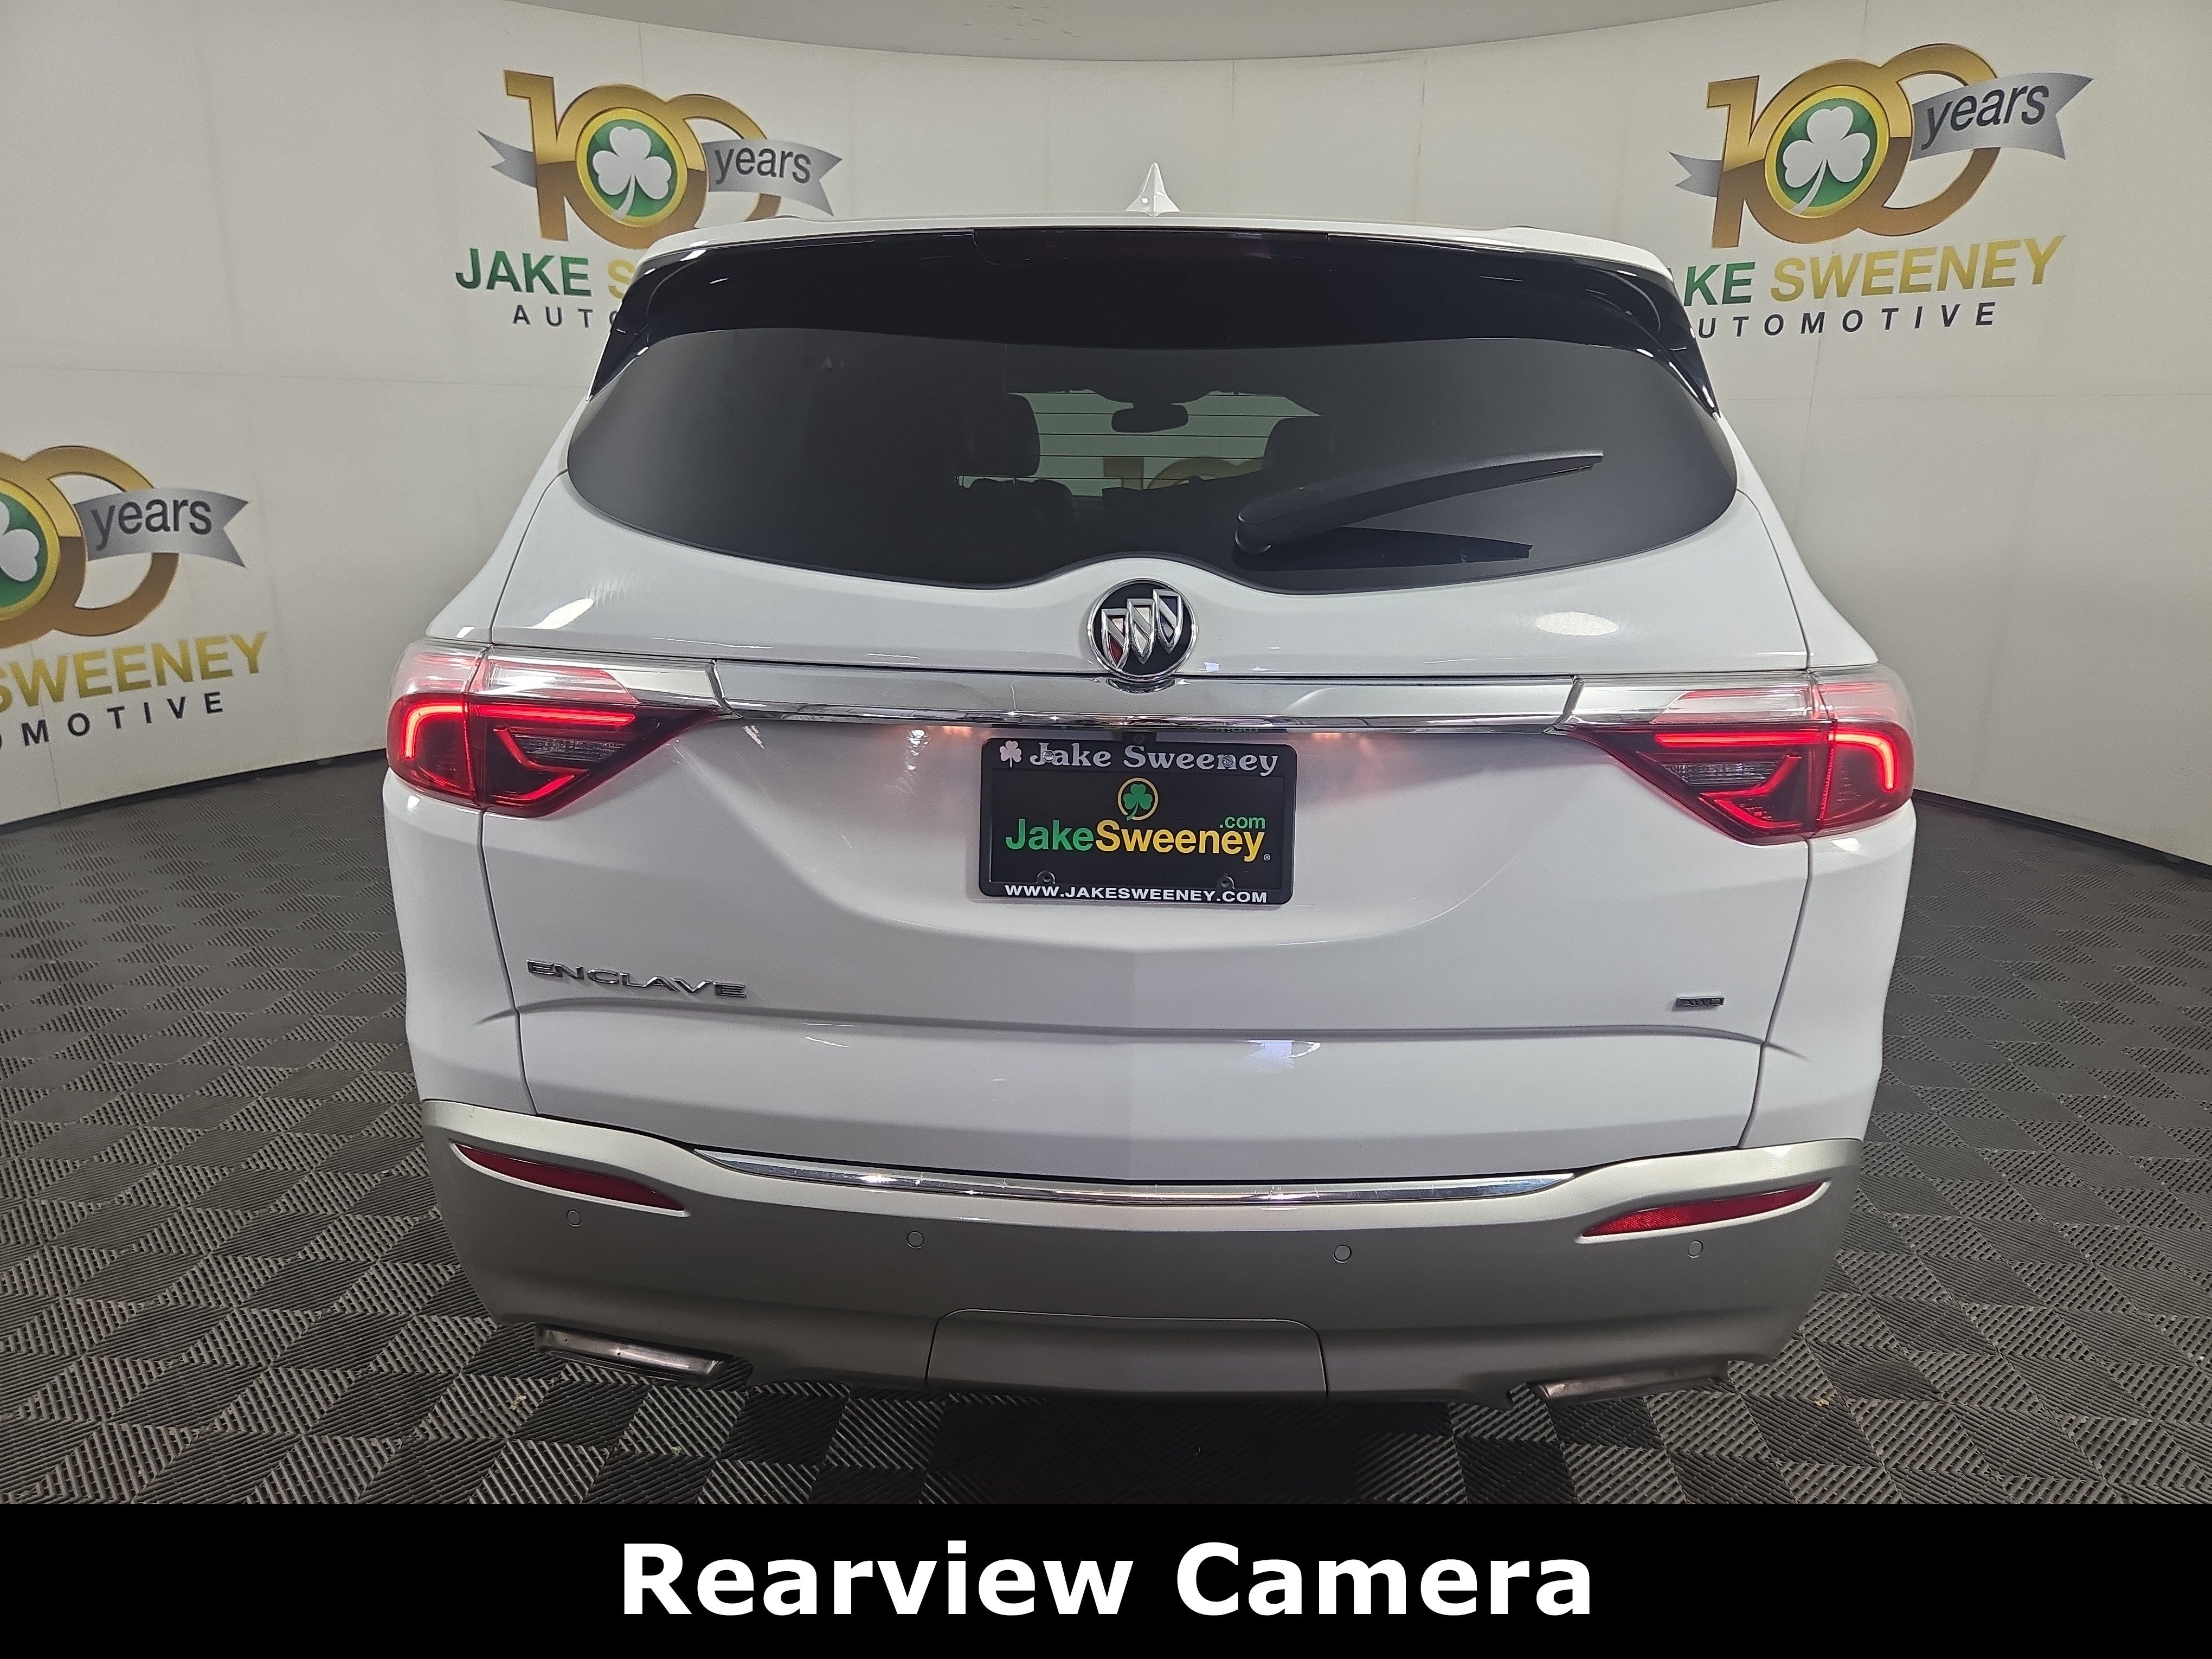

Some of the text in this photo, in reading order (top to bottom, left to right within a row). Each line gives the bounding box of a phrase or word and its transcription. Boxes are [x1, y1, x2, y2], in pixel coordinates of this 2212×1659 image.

[715, 146, 812, 184] years
[1707, 43, 2049, 249] 100 years
[455, 248, 592, 297] JAKE
[1667, 235, 2067, 307] KE SWEENEY
[1698, 301, 1996, 339] UTOMOTIVE
[91, 498, 213, 550] years
[0, 692, 223, 752] MOTIVE
[1030, 742, 1278, 776] Jake Sweeney
[1005, 885, 1267, 903] WWW.JAKESWEENEY.COM
[526, 959, 747, 998] ENCLAVE
